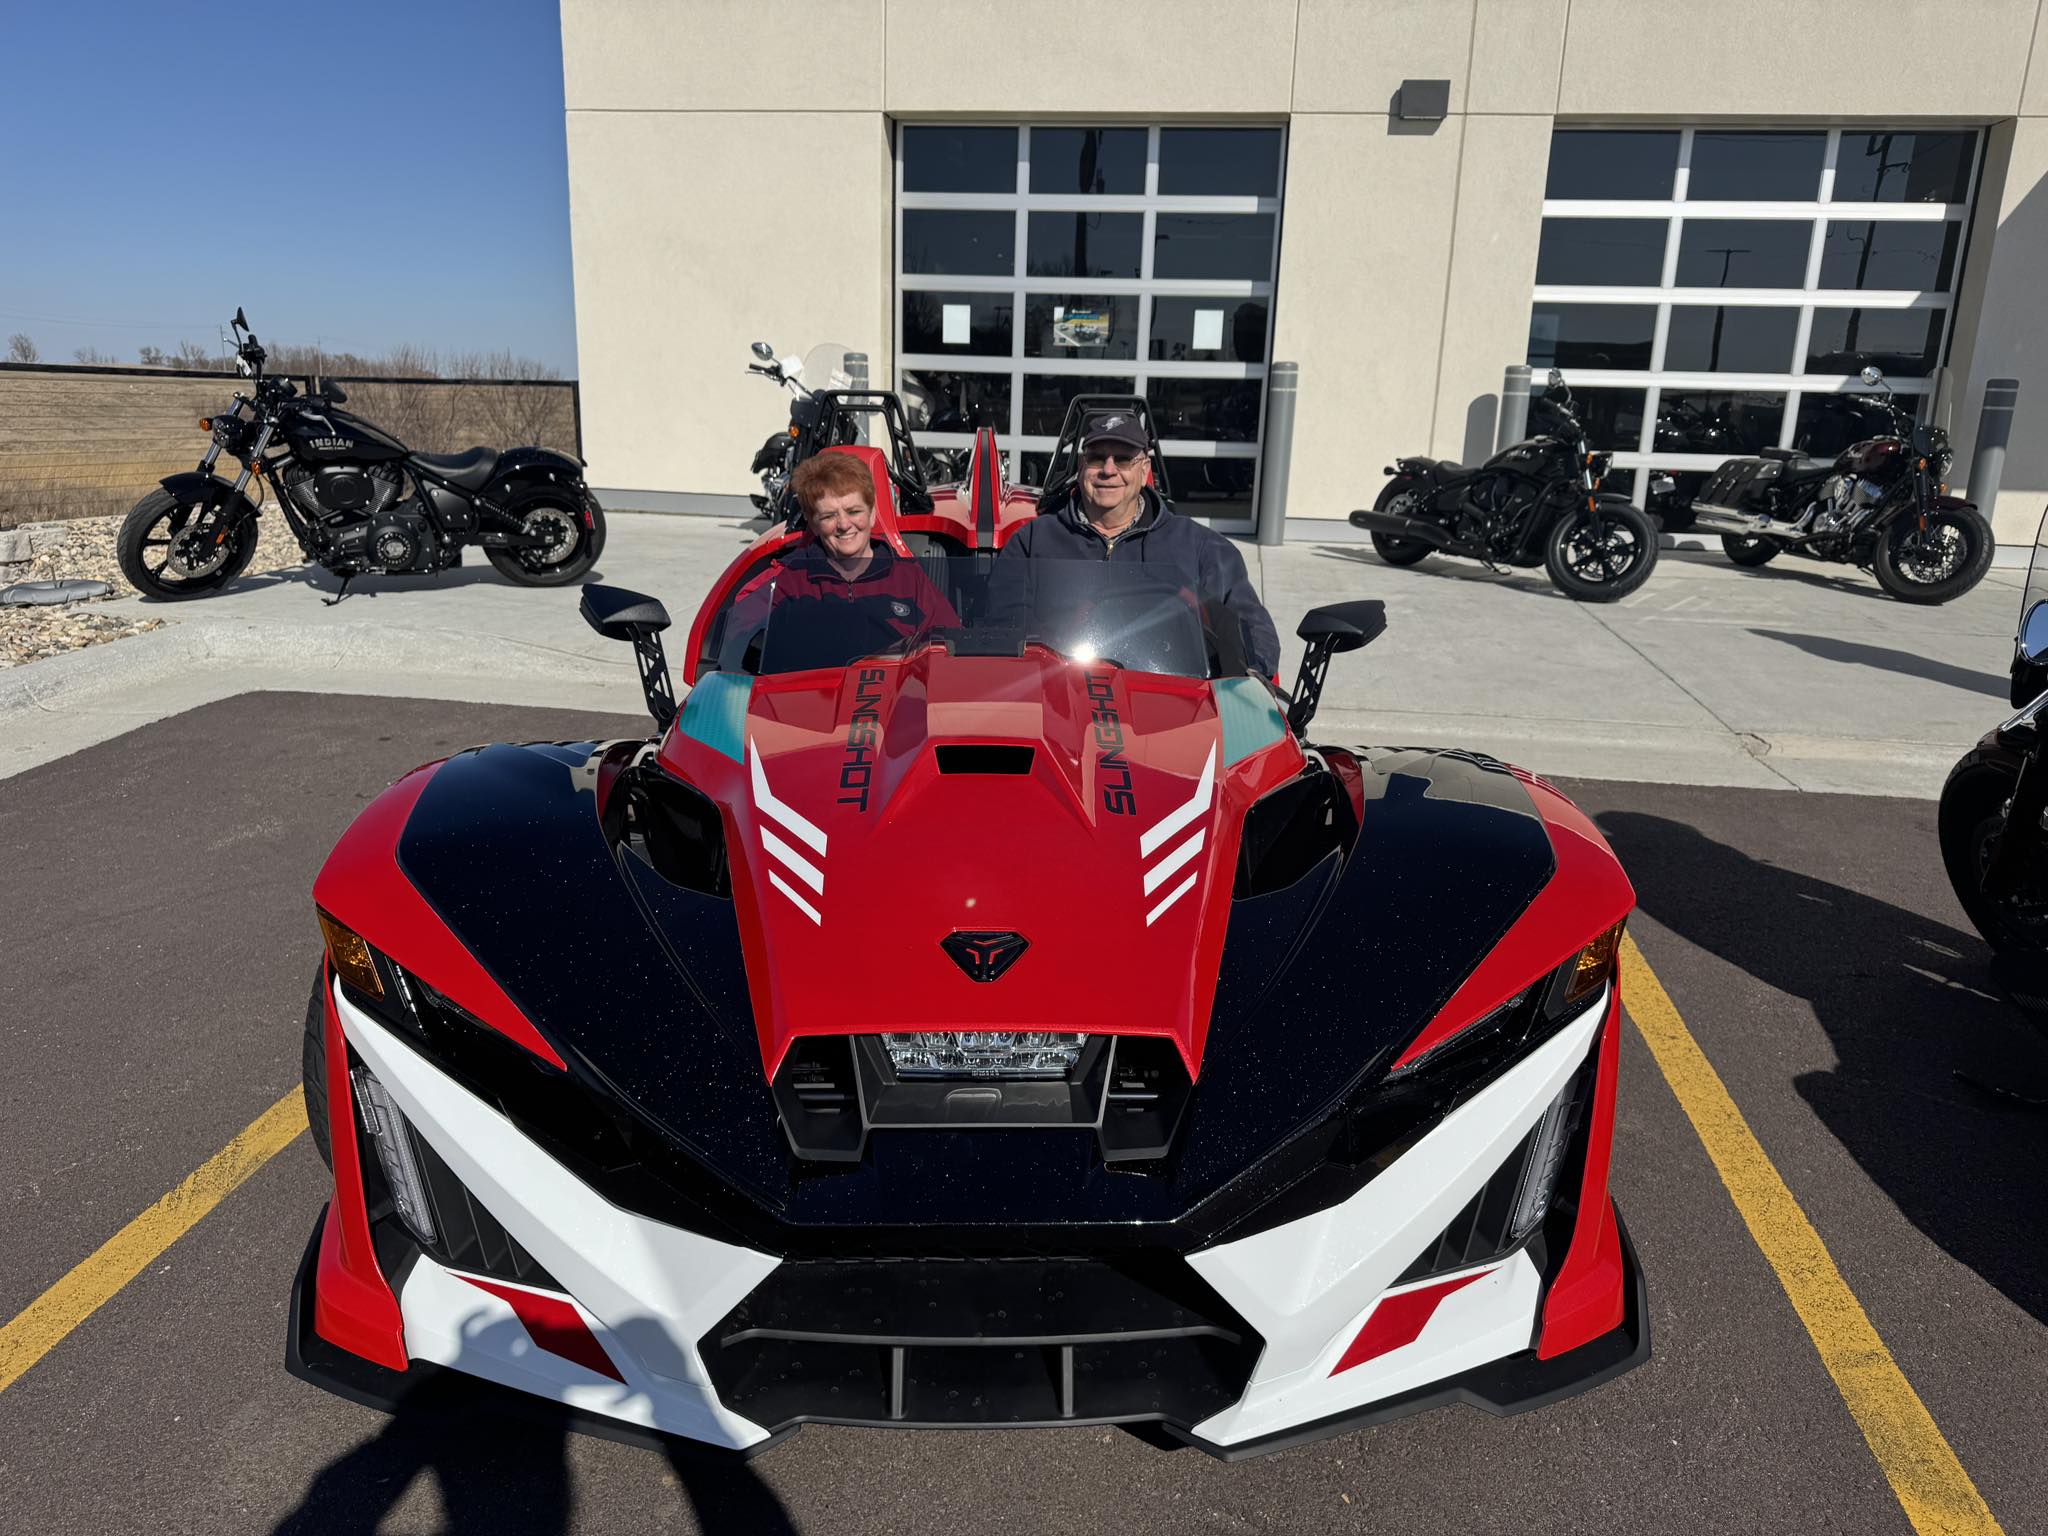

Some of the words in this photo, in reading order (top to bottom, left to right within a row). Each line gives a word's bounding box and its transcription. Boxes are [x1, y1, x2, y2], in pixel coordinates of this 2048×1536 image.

[309, 438, 354, 448] INDIAN
[837, 669, 885, 812] SLINGSHOT
[1084, 671, 1136, 816] SLINGSHOT
